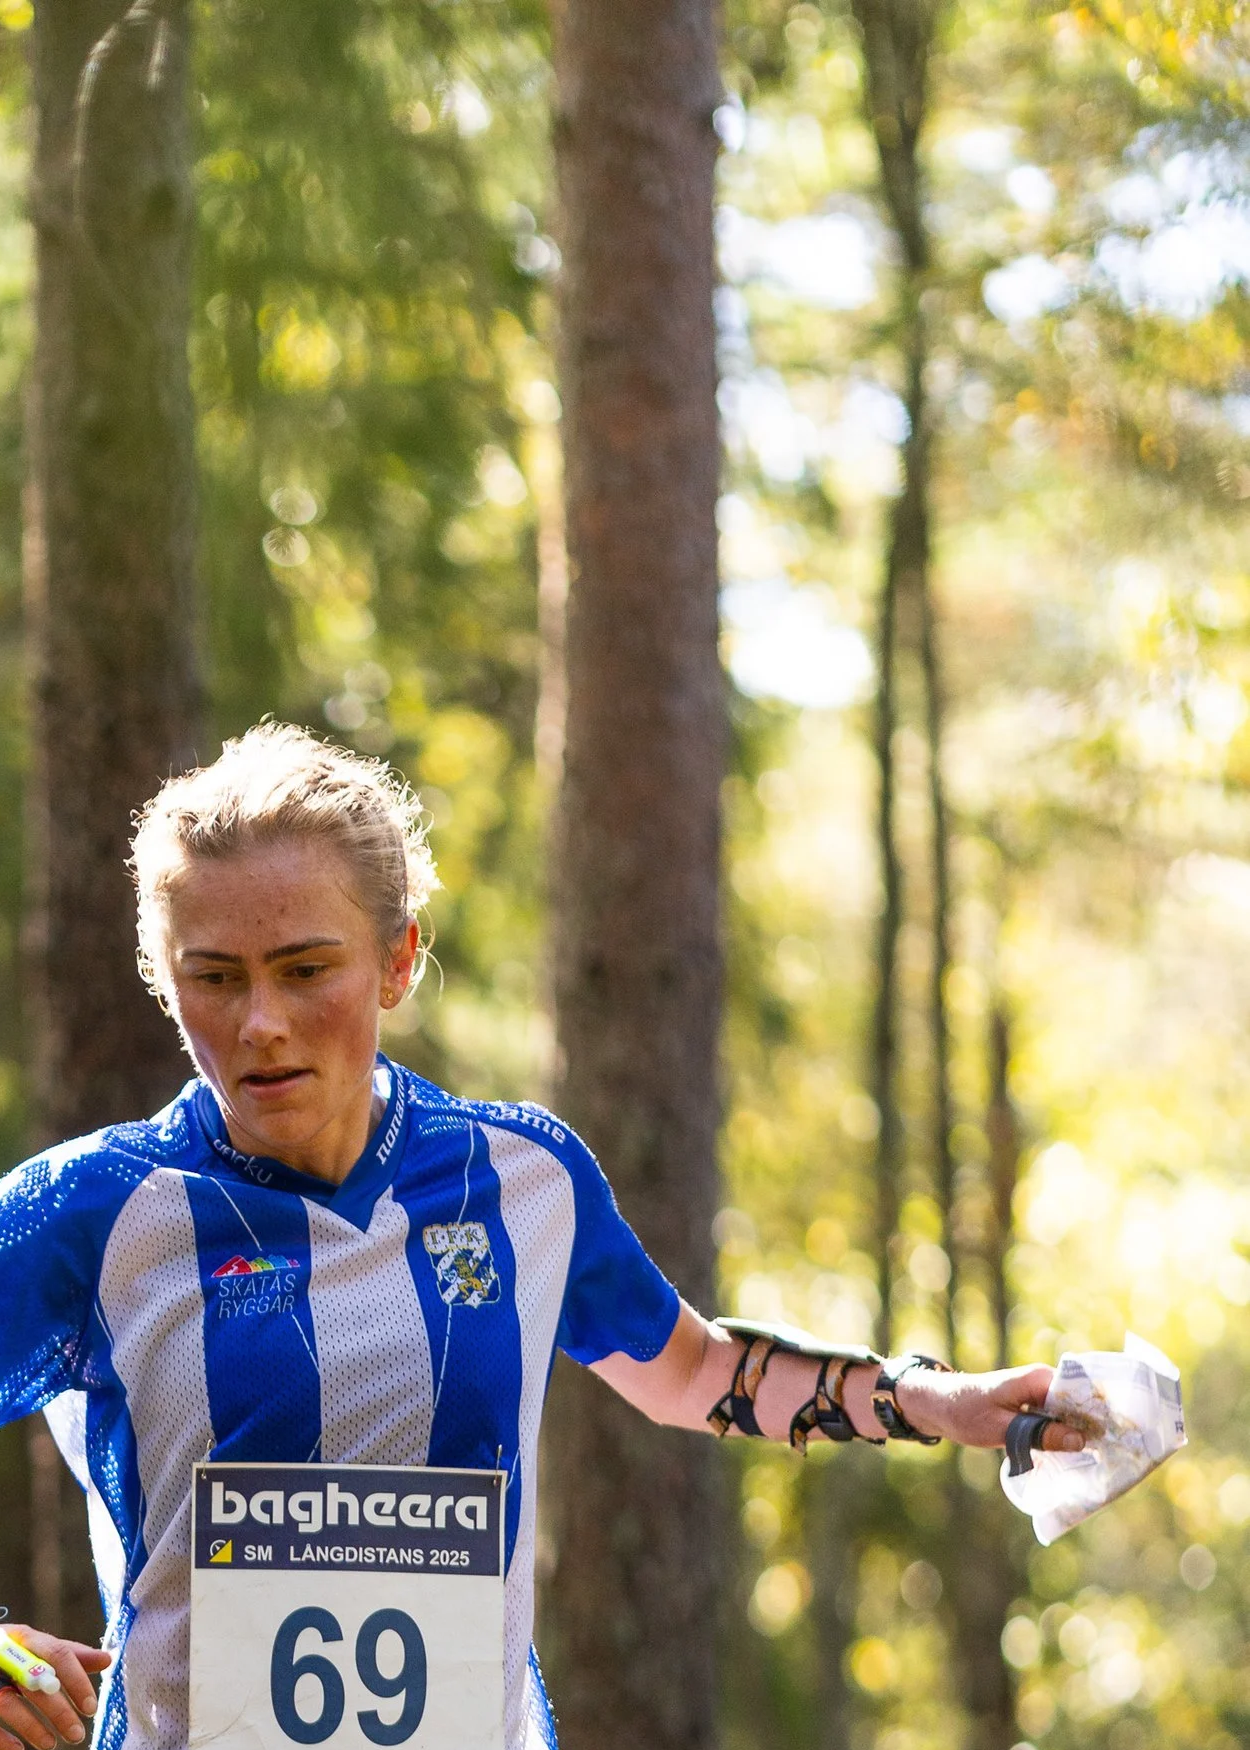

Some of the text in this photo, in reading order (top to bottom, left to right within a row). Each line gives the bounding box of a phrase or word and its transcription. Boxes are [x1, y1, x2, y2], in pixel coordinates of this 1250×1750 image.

[218, 1270, 296, 1298] SKATÅS
[218, 1294, 295, 1319] RYGGAR
[211, 1481, 488, 1533] bagheera
[244, 1543, 470, 1566] SM LÅNGDISTANS 2025
[270, 1606, 427, 1747] 69
